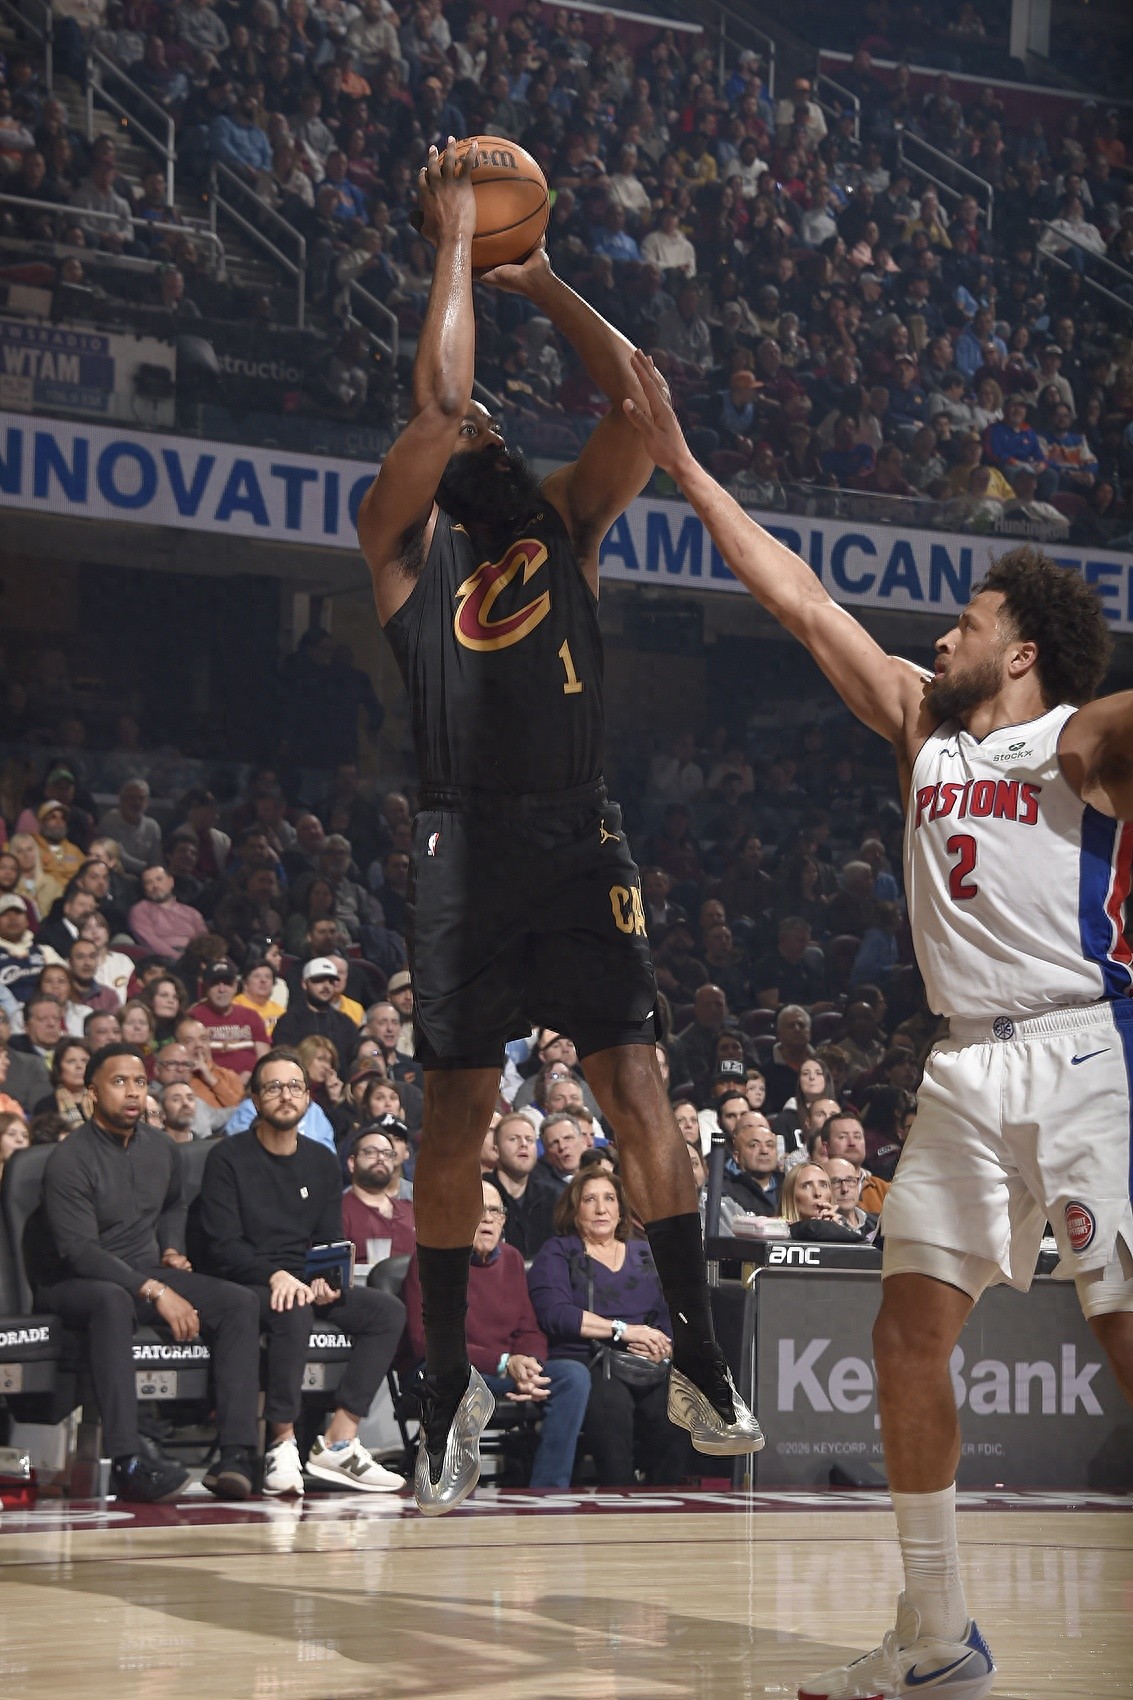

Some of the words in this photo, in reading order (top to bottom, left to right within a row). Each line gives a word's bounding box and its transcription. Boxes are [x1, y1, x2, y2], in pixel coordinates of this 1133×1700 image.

[3, 345, 80, 384] WTAM
[219, 353, 304, 383] tructio
[558, 639, 584, 694] 1
[915, 779, 1042, 830] PISTONS
[946, 834, 978, 901] 2
[776, 1338, 1104, 1430] Keank
